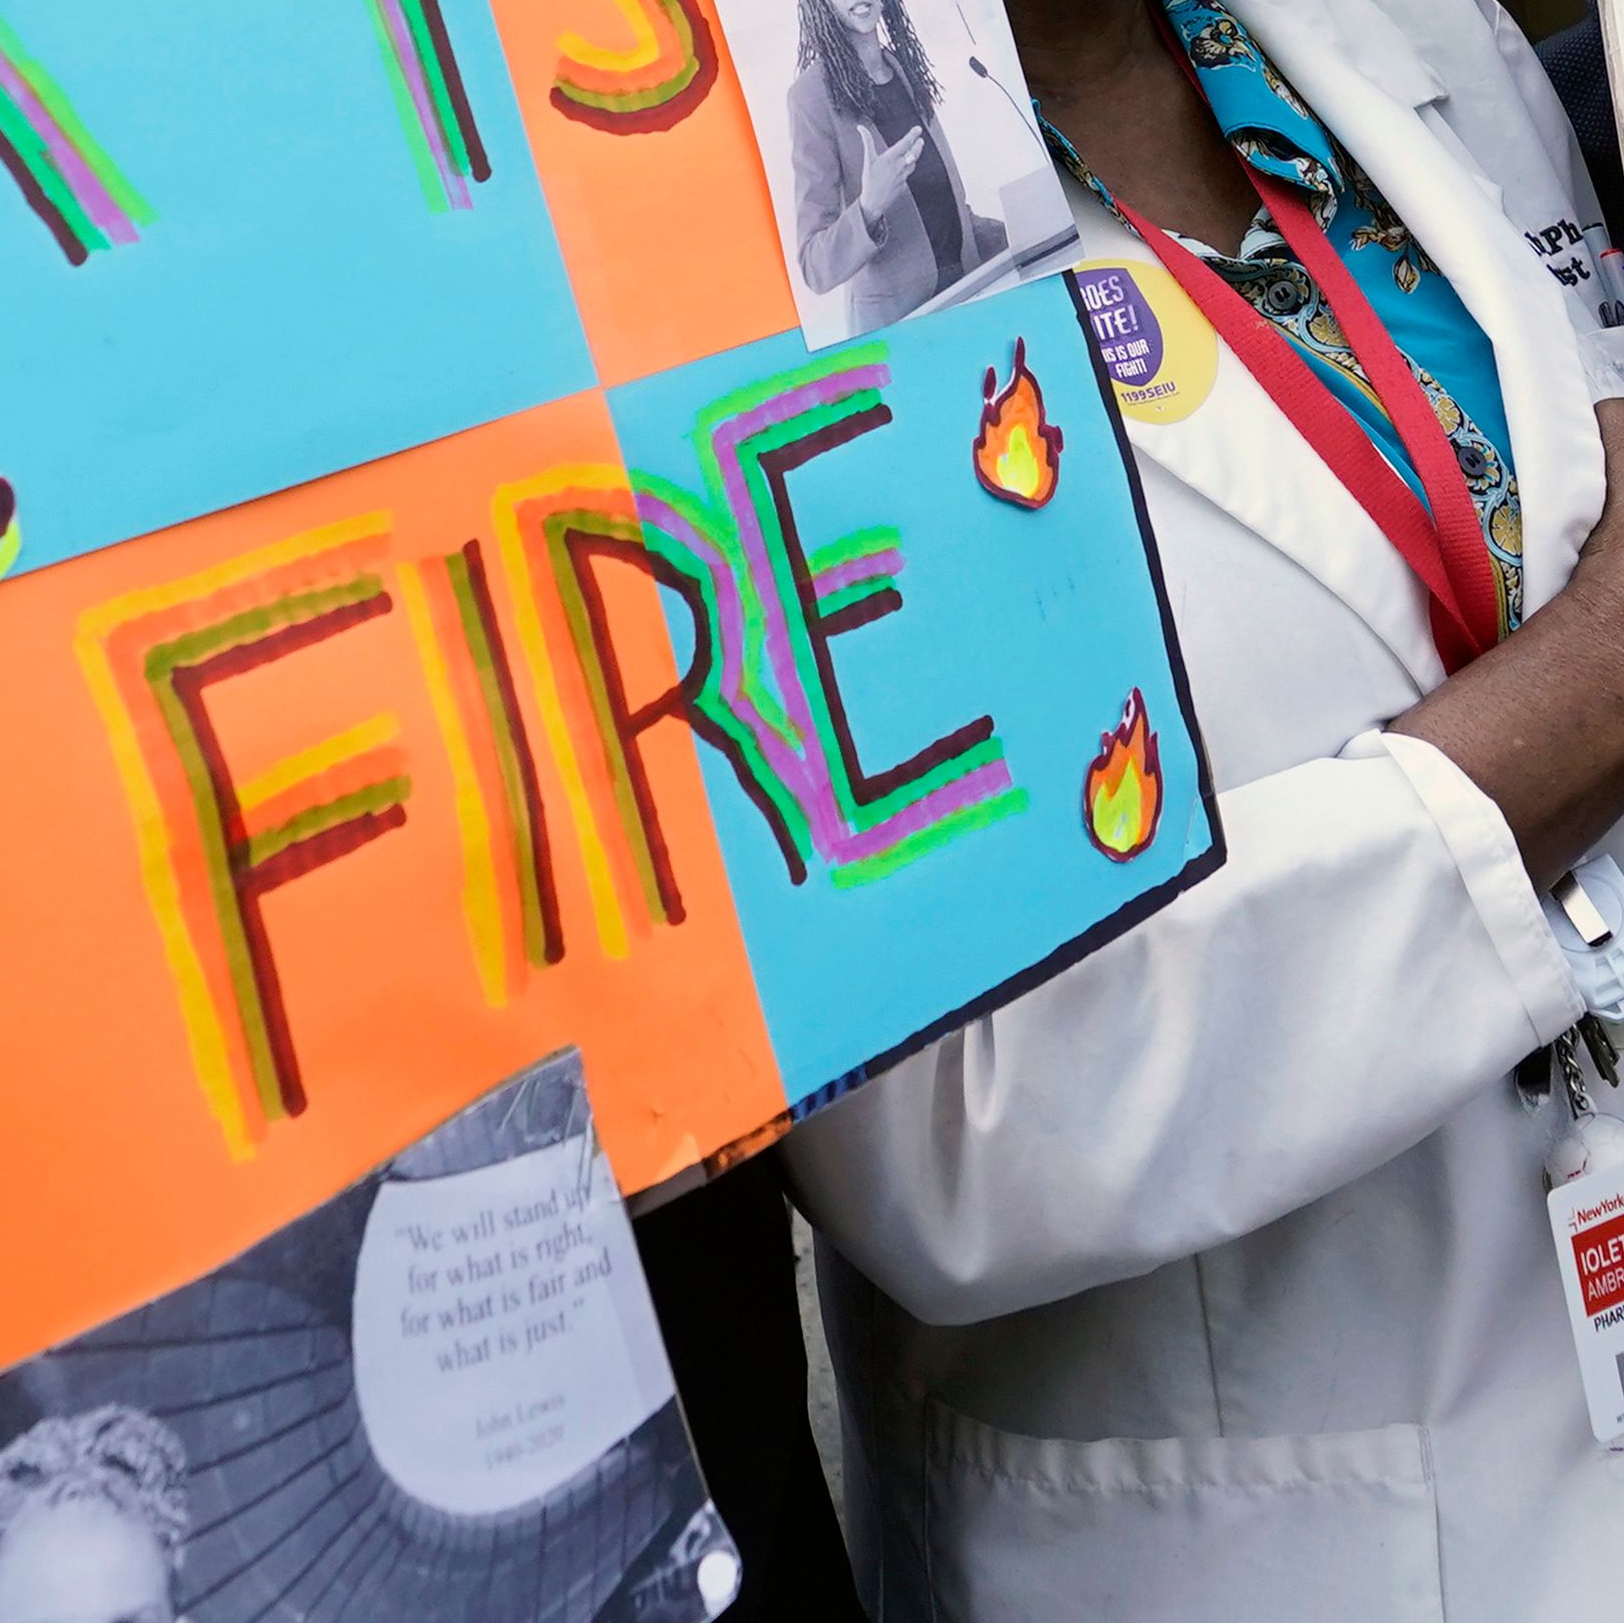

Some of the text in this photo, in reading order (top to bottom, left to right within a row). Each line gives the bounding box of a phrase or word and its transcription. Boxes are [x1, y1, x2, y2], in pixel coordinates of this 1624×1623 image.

[1127, 338, 1150, 358] OUR
[1120, 381, 1176, 403] 1199SEIU
[75, 341, 1029, 1160] FIRE
[503, 1189, 559, 1229] stand
[401, 1246, 613, 1338] for what is fair and
[407, 1263, 438, 1295] for
[446, 1252, 503, 1286] what
[510, 1248, 529, 1269] is
[436, 1337, 491, 1373] what
[498, 1332, 518, 1356] is
